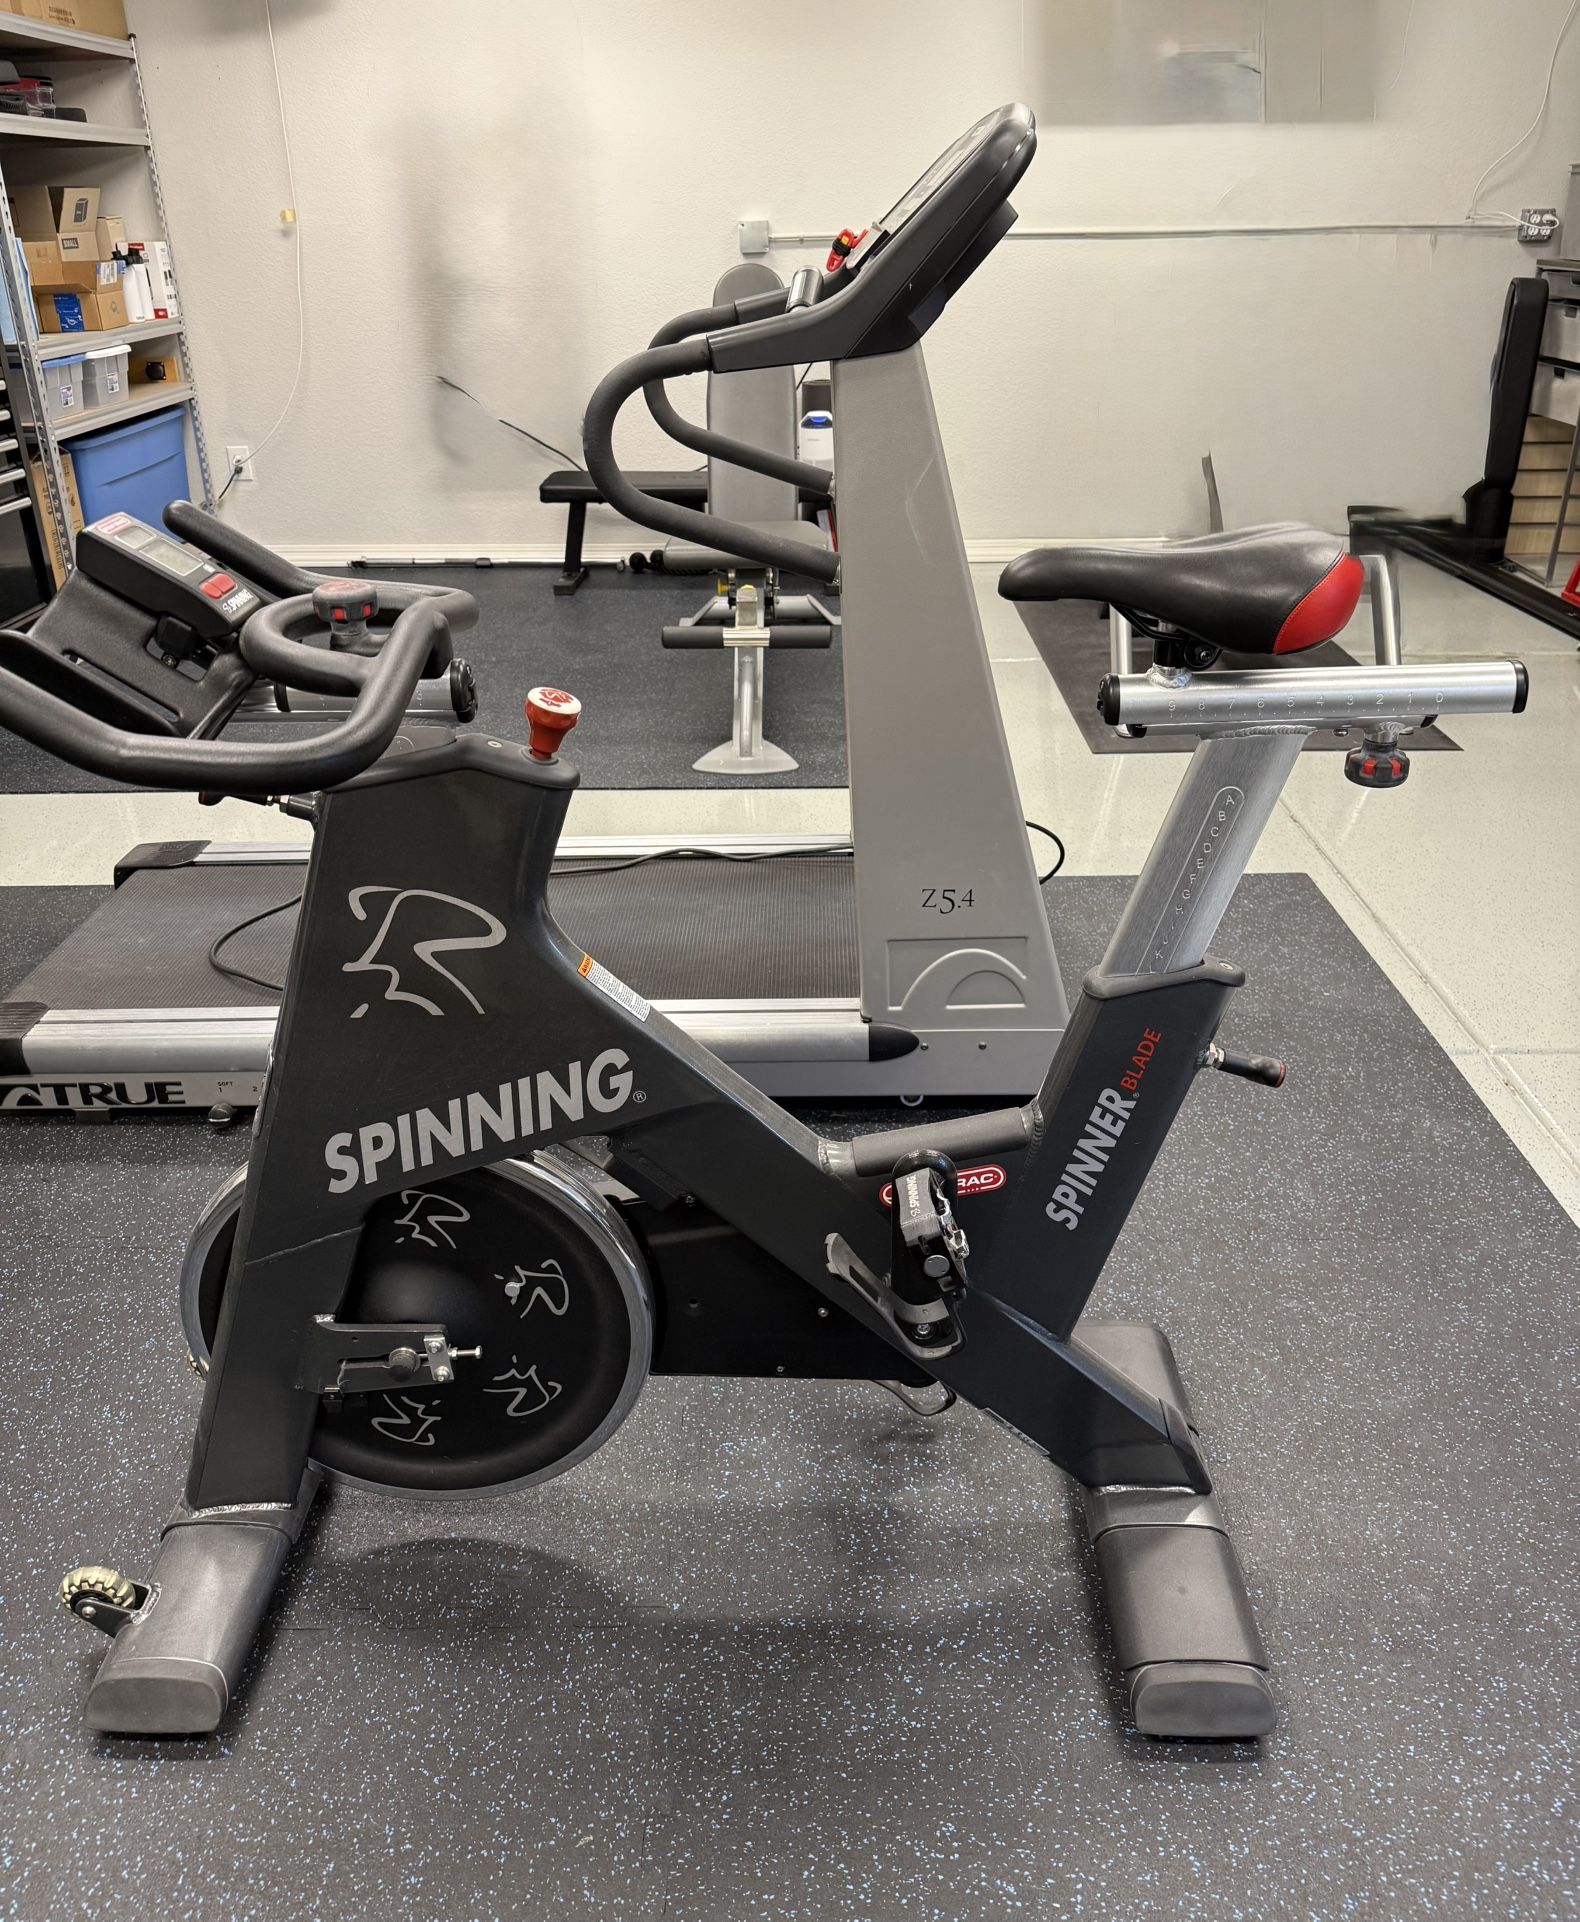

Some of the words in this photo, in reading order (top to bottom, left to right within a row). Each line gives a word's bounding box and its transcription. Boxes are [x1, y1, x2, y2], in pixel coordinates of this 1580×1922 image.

[1168, 700, 1176, 711] 9
[1198, 698, 1206, 710] 8
[1287, 696, 1295, 707] 5
[1346, 694, 1354, 706] 3
[1375, 693, 1384, 705] 2
[1407, 692, 1413, 704] 1
[1435, 692, 1444, 703] 0
[1225, 794, 1235, 806] A
[1218, 811, 1226, 821] B
[1210, 826, 1219, 837] C
[1203, 843, 1212, 853] D
[1196, 858, 1204, 869] E
[1190, 873, 1197, 884] F
[1182, 889, 1191, 899] G
[921, 888, 975, 914] Z5.4
[1120, 1027, 1163, 1091] BLADE
[39, 1081, 186, 1106] TRUE
[957, 1173, 994, 1187] RAC
